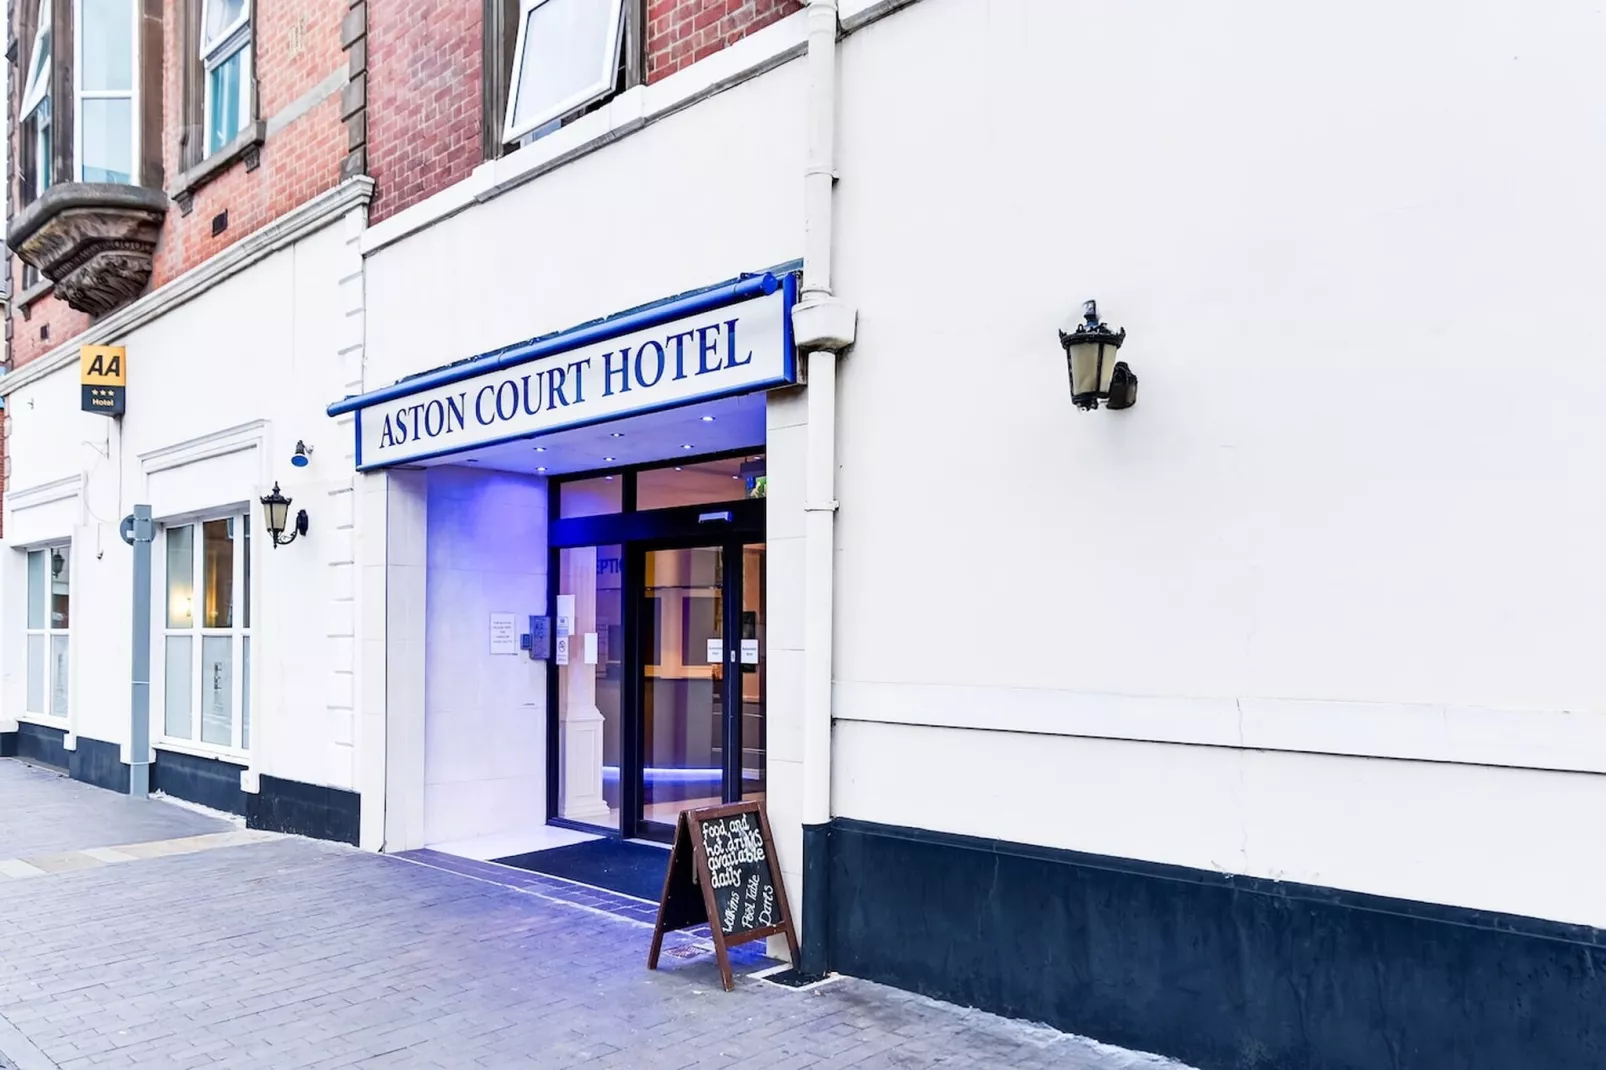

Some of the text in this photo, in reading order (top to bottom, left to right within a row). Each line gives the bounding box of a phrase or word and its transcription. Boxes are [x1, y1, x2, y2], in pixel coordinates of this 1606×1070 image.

[87, 355, 120, 377] AA
[379, 318, 752, 449] ASTON COURT HOTEL
[92, 398, 114, 406] Hotel
[729, 813, 750, 832] and
[708, 848, 765, 870] available
[711, 868, 742, 888] daily
[741, 874, 760, 928] Pool Table
[758, 885, 774, 927] Darts
